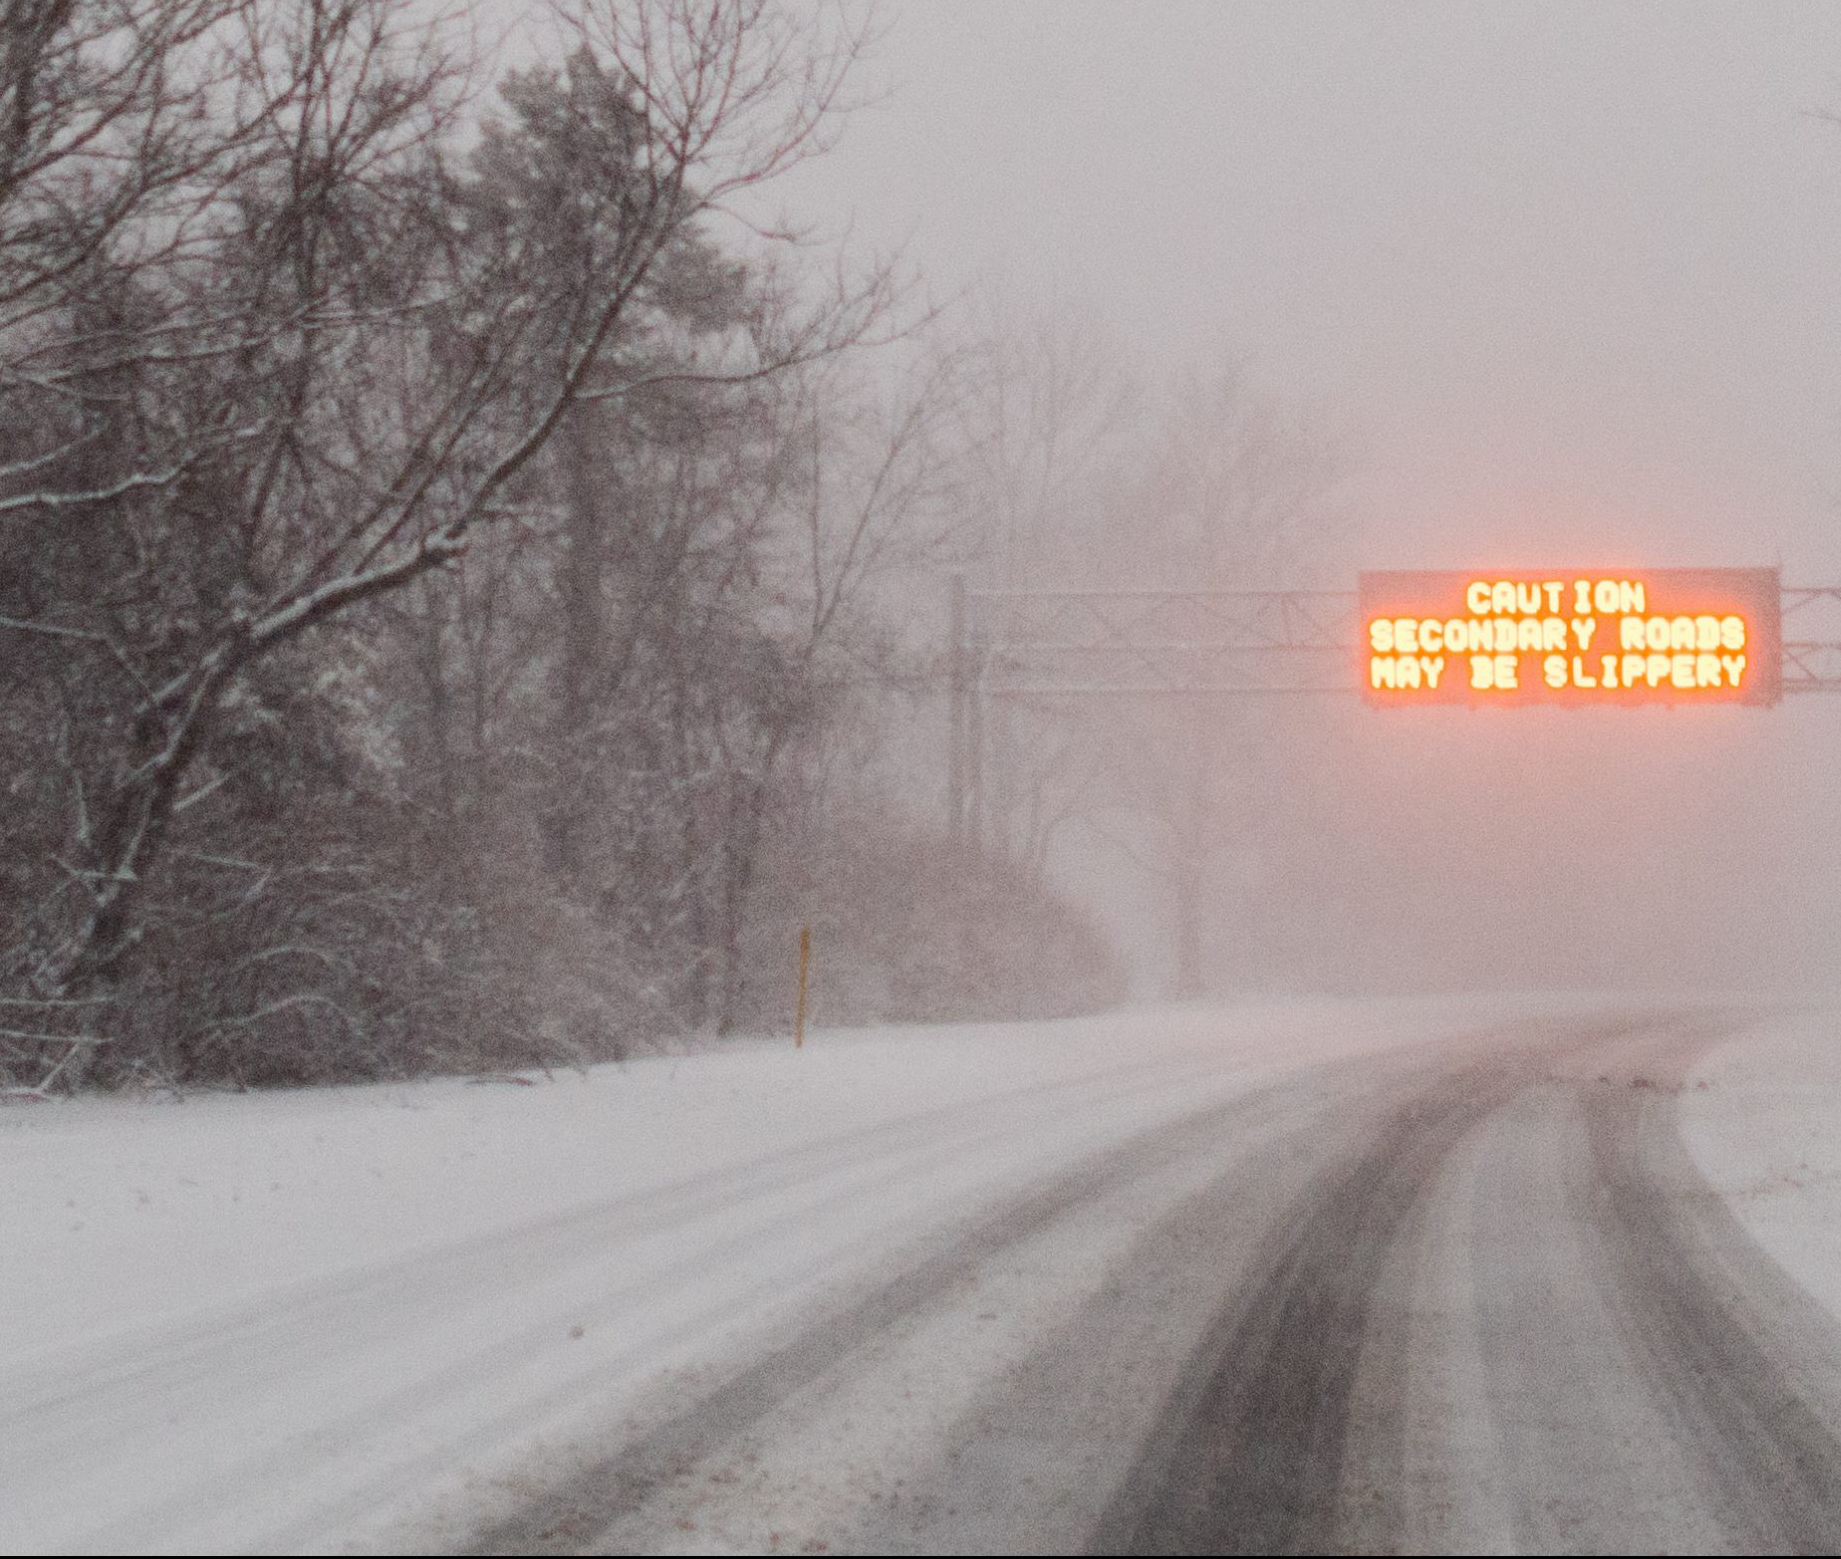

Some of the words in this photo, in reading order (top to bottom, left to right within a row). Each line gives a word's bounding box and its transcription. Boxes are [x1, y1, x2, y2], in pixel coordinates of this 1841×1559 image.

[1467, 580, 1645, 614] CAUTION
[1369, 617, 1596, 652] SECONDARY
[1621, 615, 1745, 651] ROADS
[1370, 655, 1444, 689] MAY
[1470, 655, 1518, 689] BE
[1543, 654, 1746, 689] SLIPPERY
